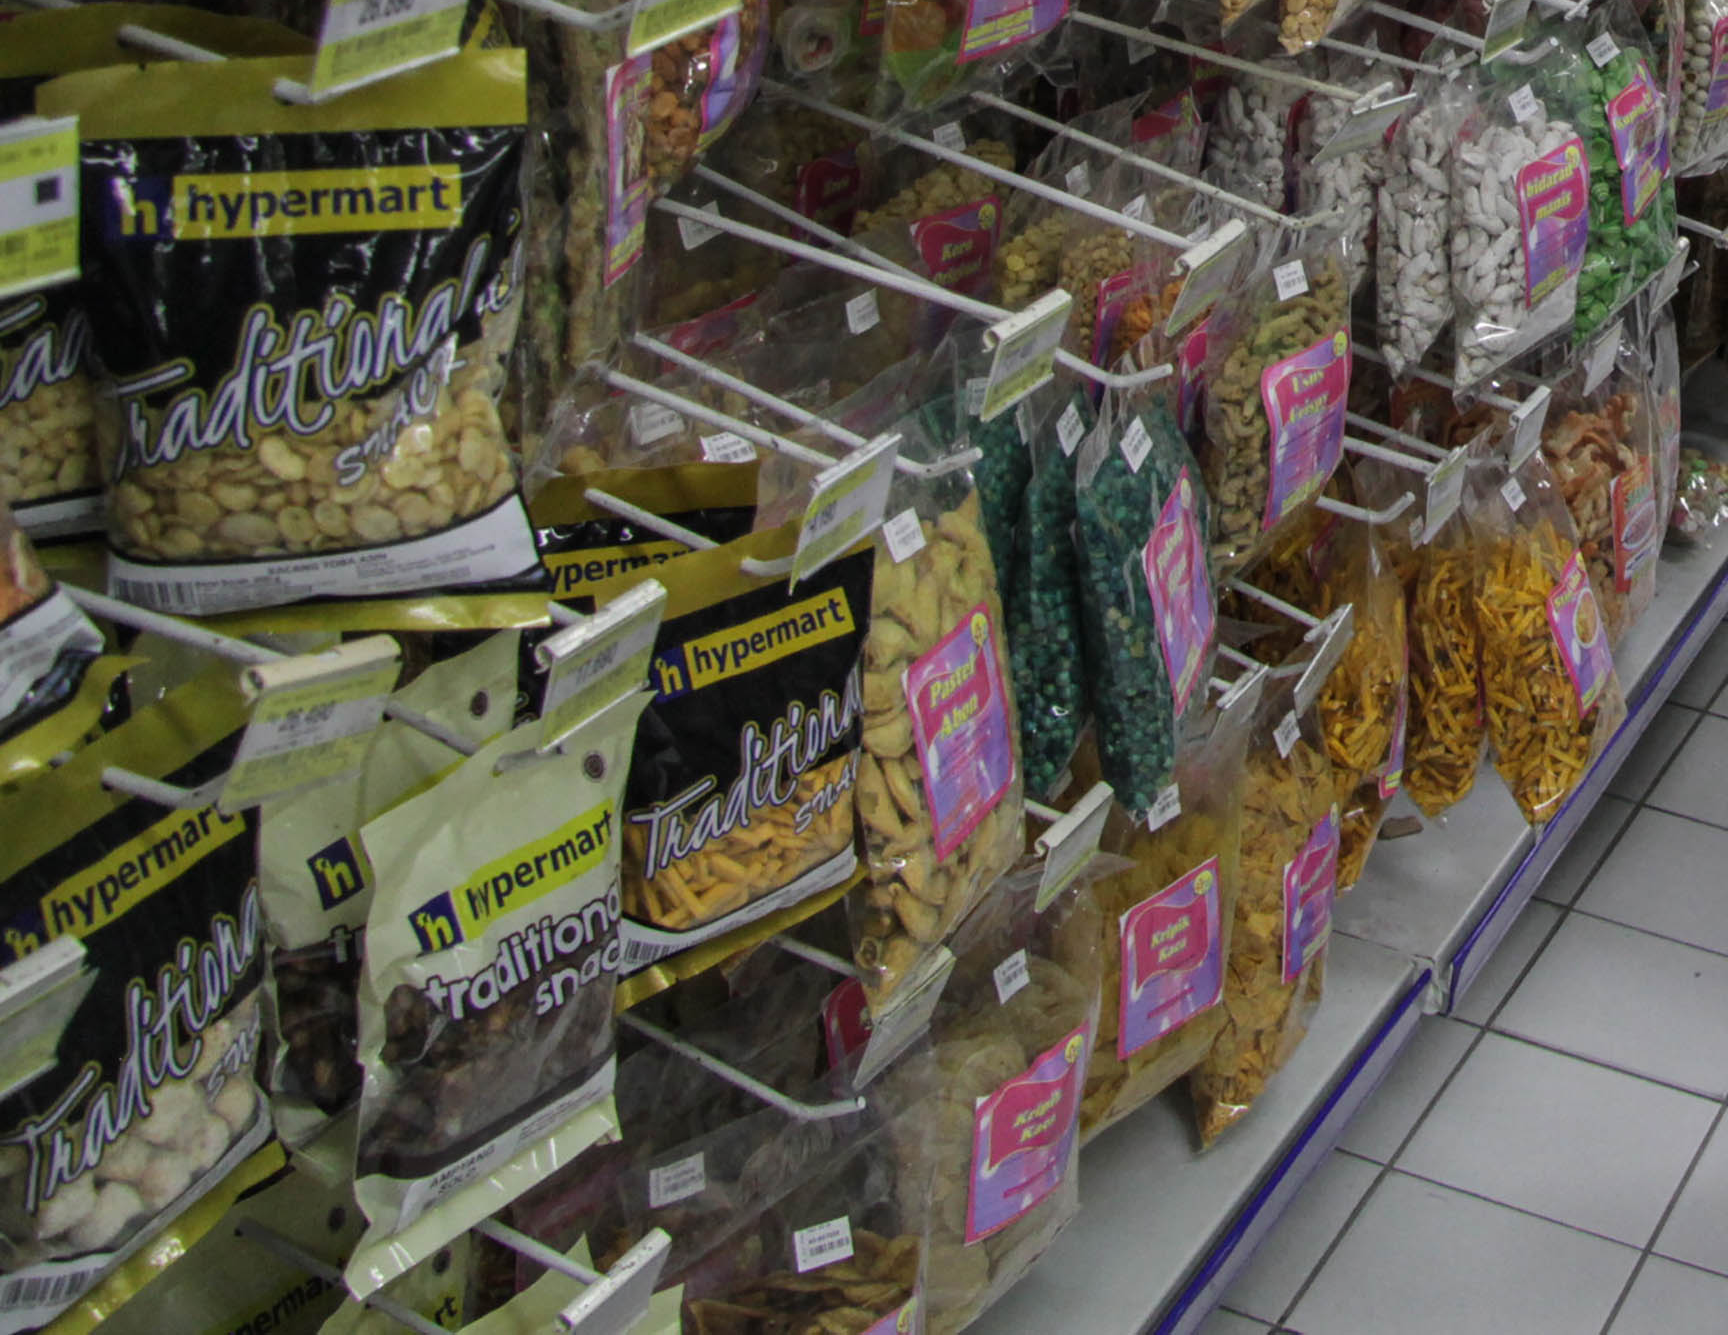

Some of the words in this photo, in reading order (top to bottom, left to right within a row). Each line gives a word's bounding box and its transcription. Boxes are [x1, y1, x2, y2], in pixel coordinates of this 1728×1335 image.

[186, 175, 452, 230] hypermart
[692, 598, 846, 676] hypermart
[630, 664, 864, 881] Traditiona
[466, 809, 614, 921] hypermart
[424, 876, 621, 1021] traditiona
[1149, 915, 1192, 950] Kripik
[535, 936, 622, 1017] snac
[0, 878, 260, 1216] Traditiona
[1013, 1087, 1063, 1129] Kripik
